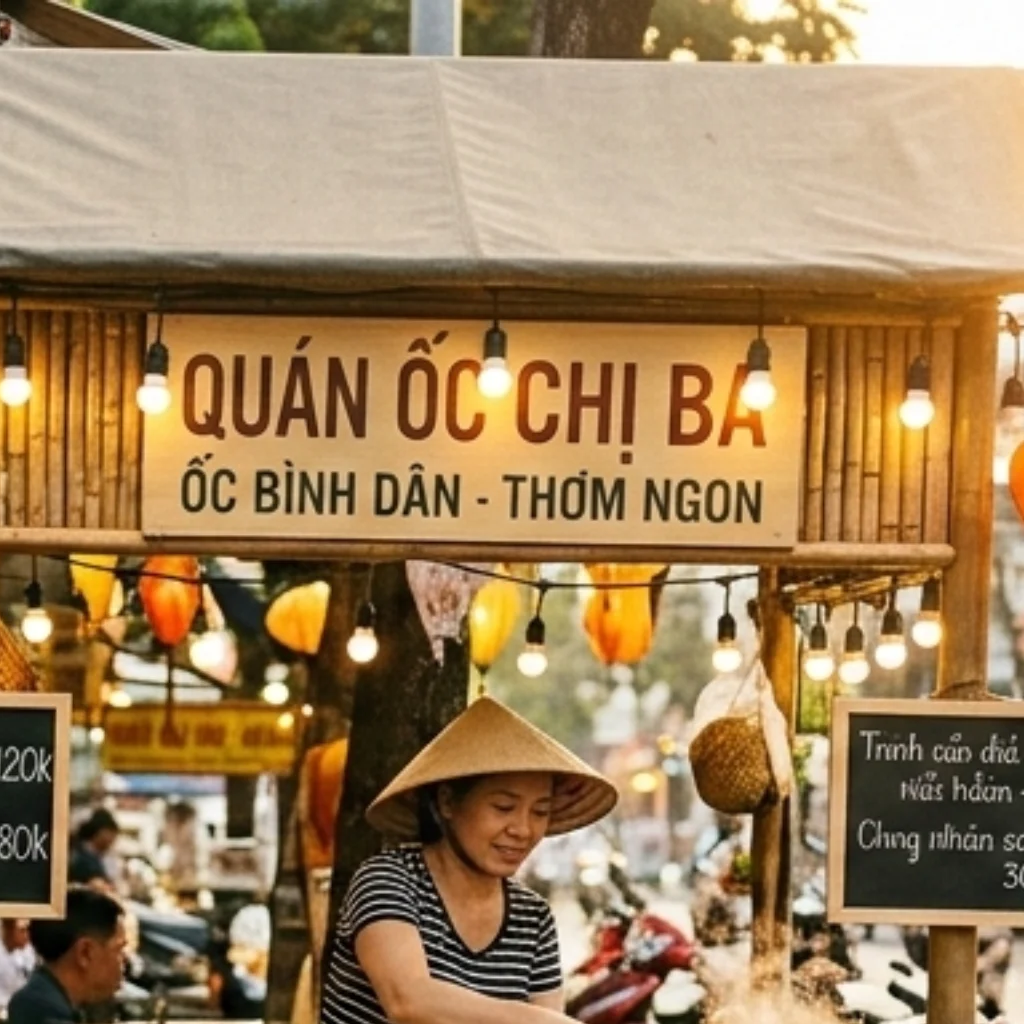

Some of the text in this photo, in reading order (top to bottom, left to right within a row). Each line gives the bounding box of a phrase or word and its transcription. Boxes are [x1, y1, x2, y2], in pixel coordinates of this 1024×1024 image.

[183, 330, 766, 464] QUÁN ỐC CHỊ BA
[181, 452, 236, 513] ỐC
[254, 459, 356, 516] BÌNH
[374, 463, 460, 517] DÂN
[502, 470, 626, 521] THƠM
[643, 478, 762, 524] NGON
